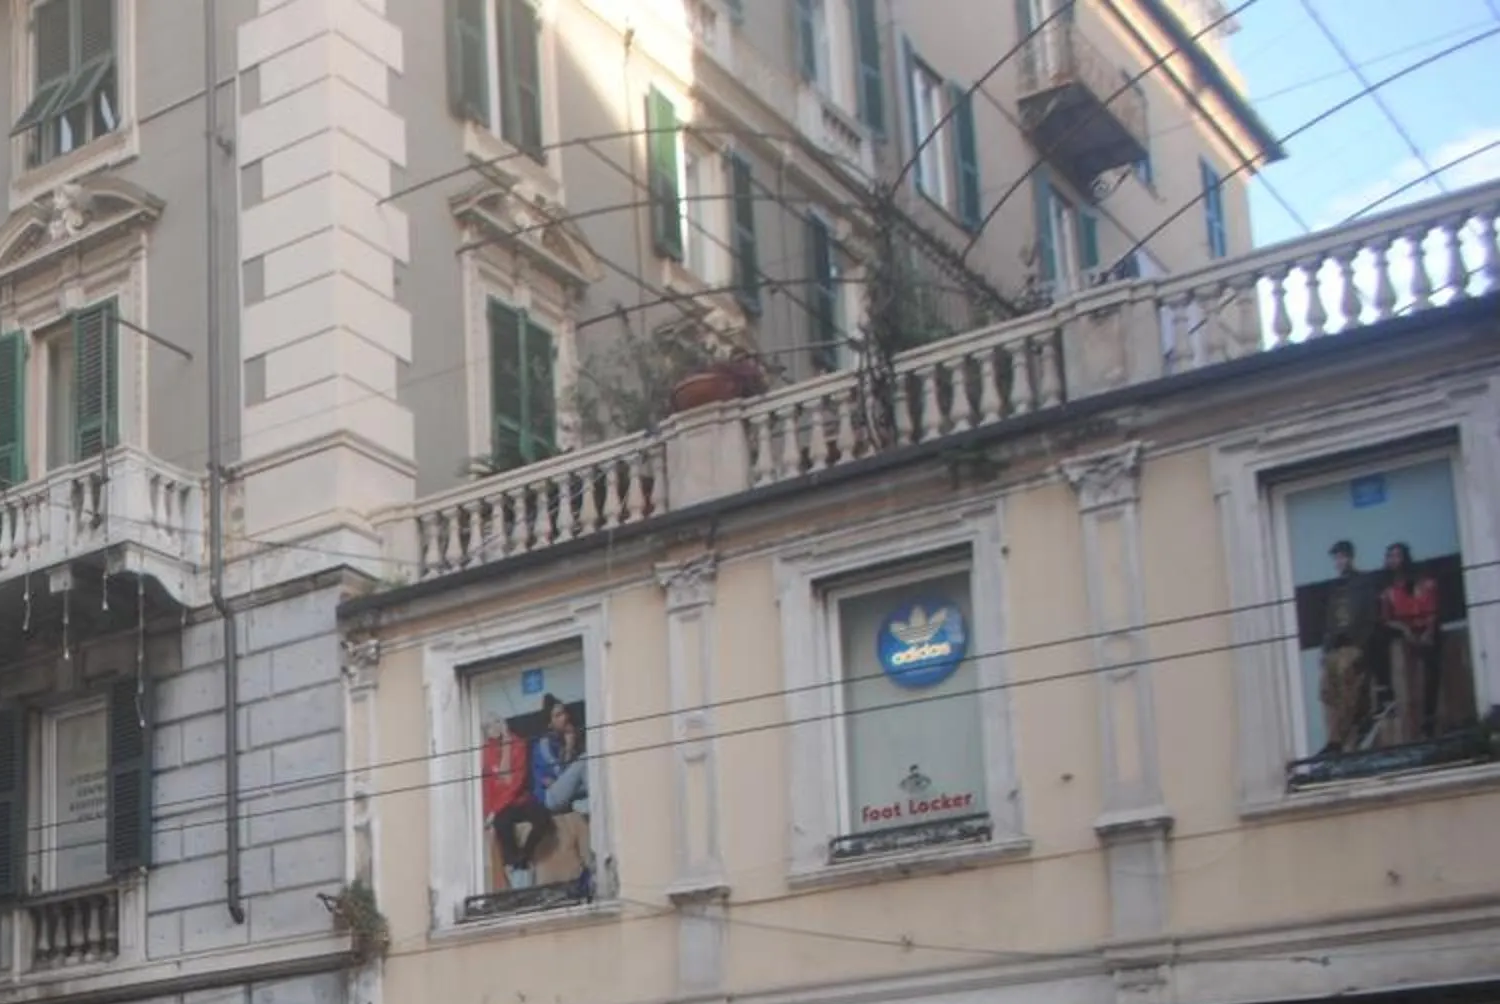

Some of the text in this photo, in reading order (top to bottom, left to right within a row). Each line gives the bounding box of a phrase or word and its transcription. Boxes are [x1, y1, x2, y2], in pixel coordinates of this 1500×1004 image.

[891, 640, 951, 665] adidas
[863, 793, 973, 823] Foot Locker
